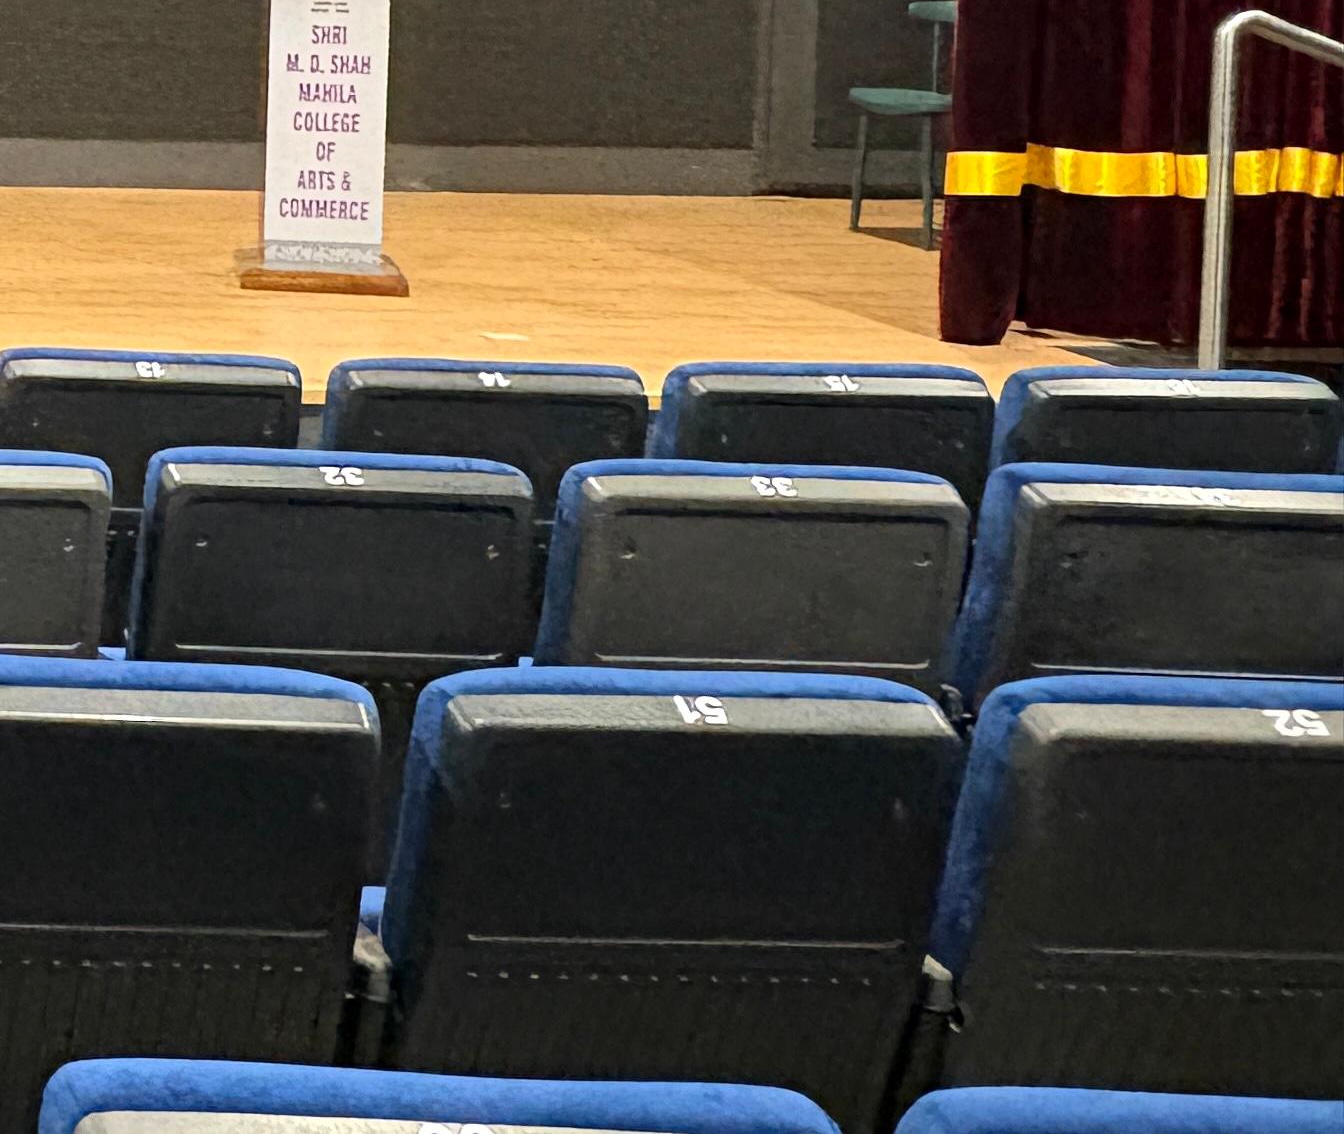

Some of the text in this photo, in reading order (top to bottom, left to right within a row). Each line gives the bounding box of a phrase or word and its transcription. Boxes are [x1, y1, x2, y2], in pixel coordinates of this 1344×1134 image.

[311, 24, 348, 46] SHRI
[285, 52, 305, 73] M.
[329, 53, 372, 76] SHAH
[298, 82, 358, 105] MAHILA
[293, 110, 361, 134] COLLEGE
[315, 140, 337, 163] OF
[296, 169, 352, 192] ARTS &
[279, 197, 371, 222] COMMERCE
[750, 475, 797, 497] 33
[673, 695, 729, 725] 51
[1261, 709, 1331, 737] 52
